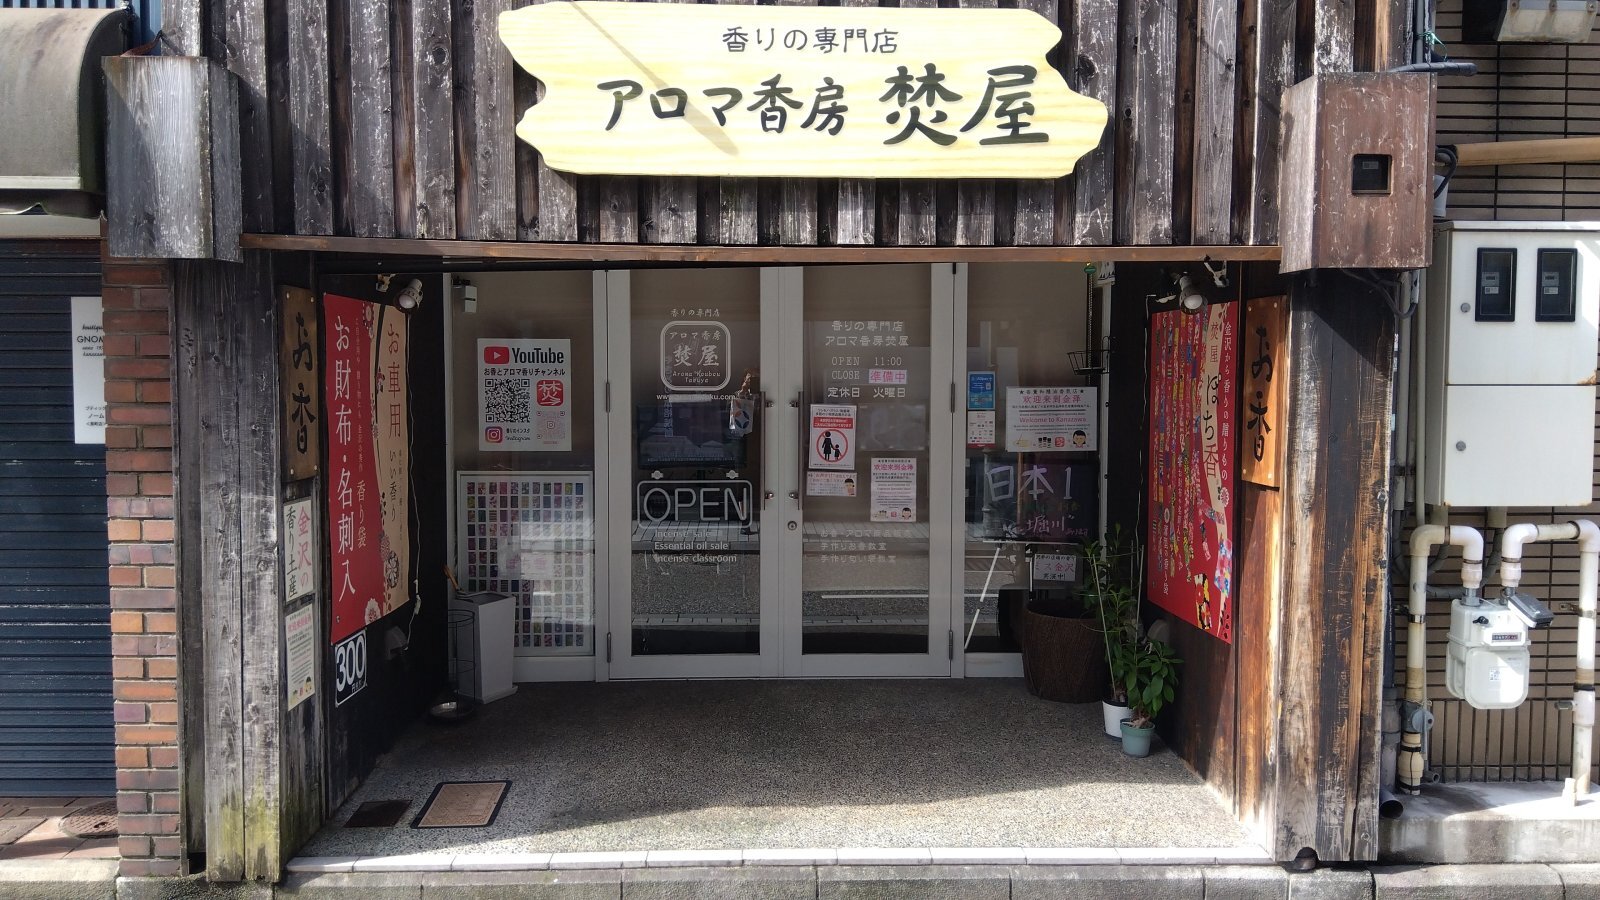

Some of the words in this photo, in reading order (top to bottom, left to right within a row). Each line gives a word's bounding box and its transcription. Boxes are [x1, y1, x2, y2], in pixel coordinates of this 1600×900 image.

[722, 26, 898, 53] 香りの専門店
[597, 73, 849, 136] アロマ香房
[879, 62, 1049, 147] 焚屋
[669, 330, 721, 341] アロマ香房
[831, 320, 904, 331] 香りの専門店
[511, 347, 565, 364] YouTube
[672, 344, 720, 367] 焚屋
[1210, 321, 1219, 363] 焚屋
[483, 368, 566, 376] お香とアロマ香りチャンネル
[831, 356, 860, 366] OPEN
[874, 356, 902, 366] 11:00
[831, 370, 860, 380] CLOSE
[870, 370, 906, 383] 準備中
[291, 311, 316, 454] お香
[387, 323, 400, 439] お車用
[828, 387, 860, 398] 定休日
[873, 387, 906, 398] 火曜日
[1247, 325, 1273, 462] お香
[1221, 321, 1232, 481] 金沢から香りの贈りもの
[356, 480, 367, 548] 香り袋
[643, 487, 747, 522] OPEN
[286, 506, 299, 599] 香り土産
[296, 506, 311, 587] 金沢の
[654, 541, 694, 550] Essential
[696, 541, 707, 550] oil
[710, 541, 729, 550] sale
[336, 635, 365, 692] 300
